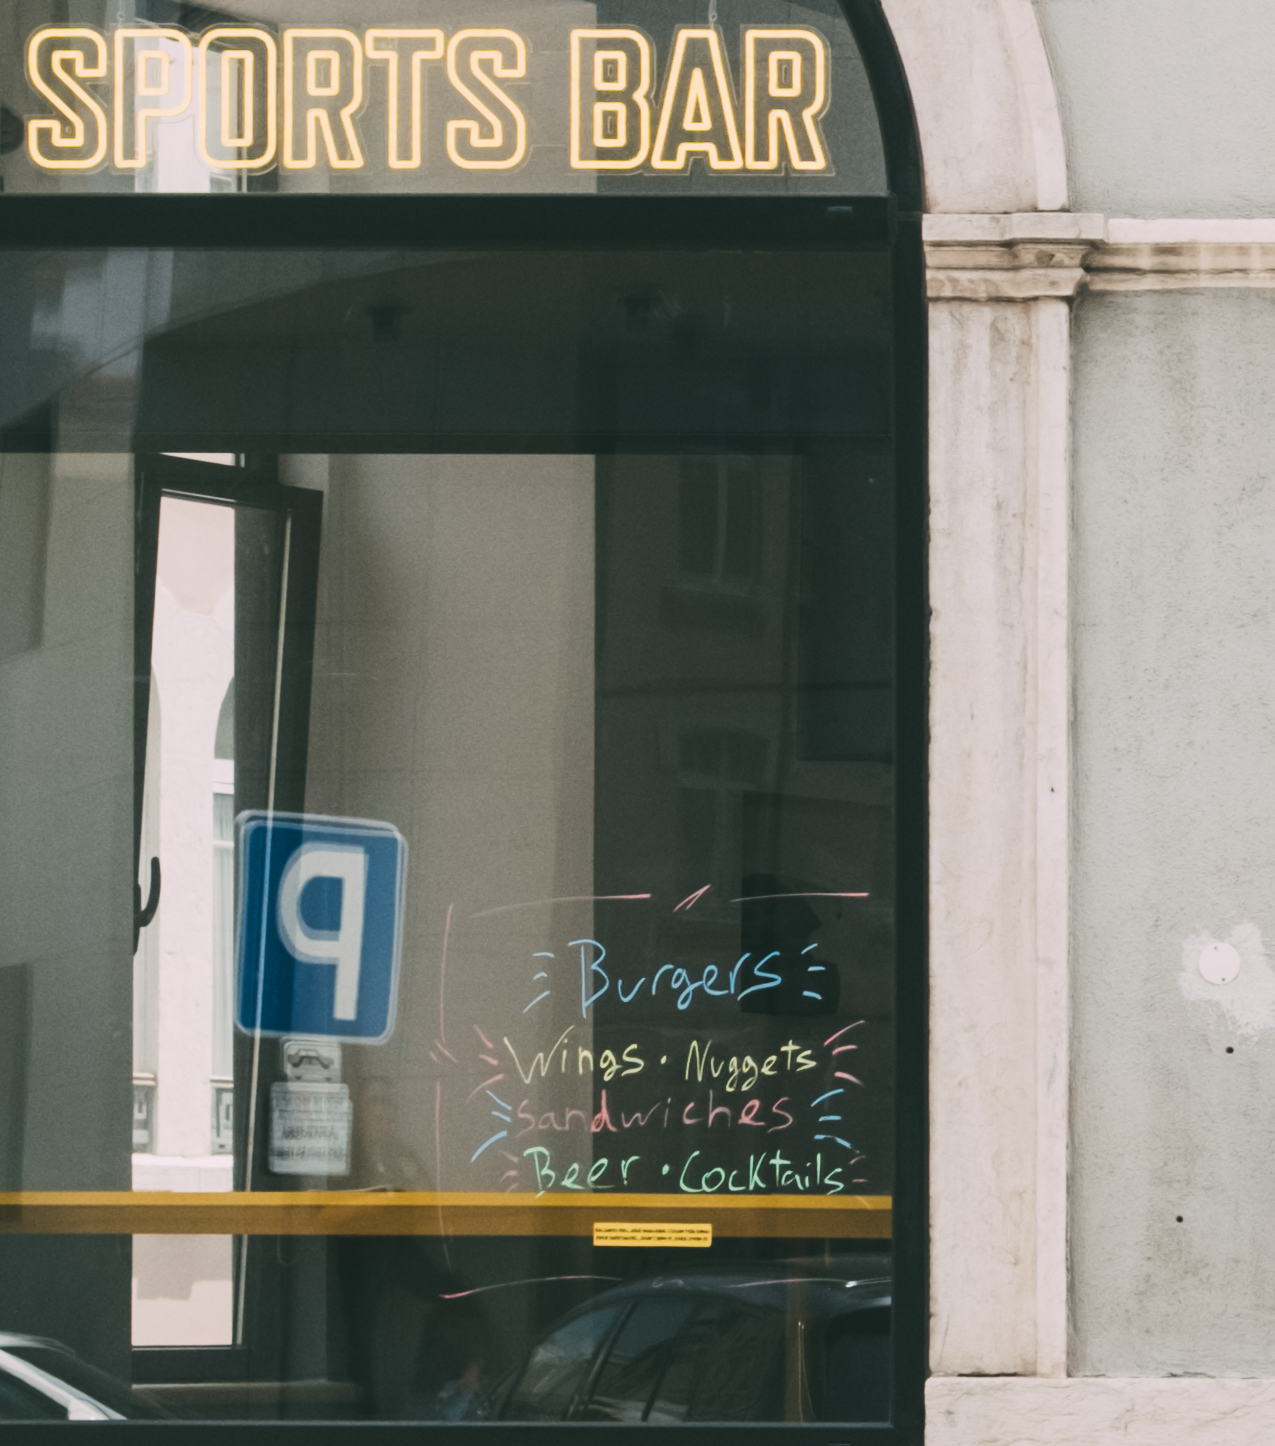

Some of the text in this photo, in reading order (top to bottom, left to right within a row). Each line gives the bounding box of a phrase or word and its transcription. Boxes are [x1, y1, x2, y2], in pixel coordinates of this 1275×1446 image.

[26, 26, 828, 171] SPORTS BAR
[567, 938, 783, 1019] Burgers
[503, 1025, 818, 1093] Wings Nuggets
[522, 1146, 640, 1199] Beer
